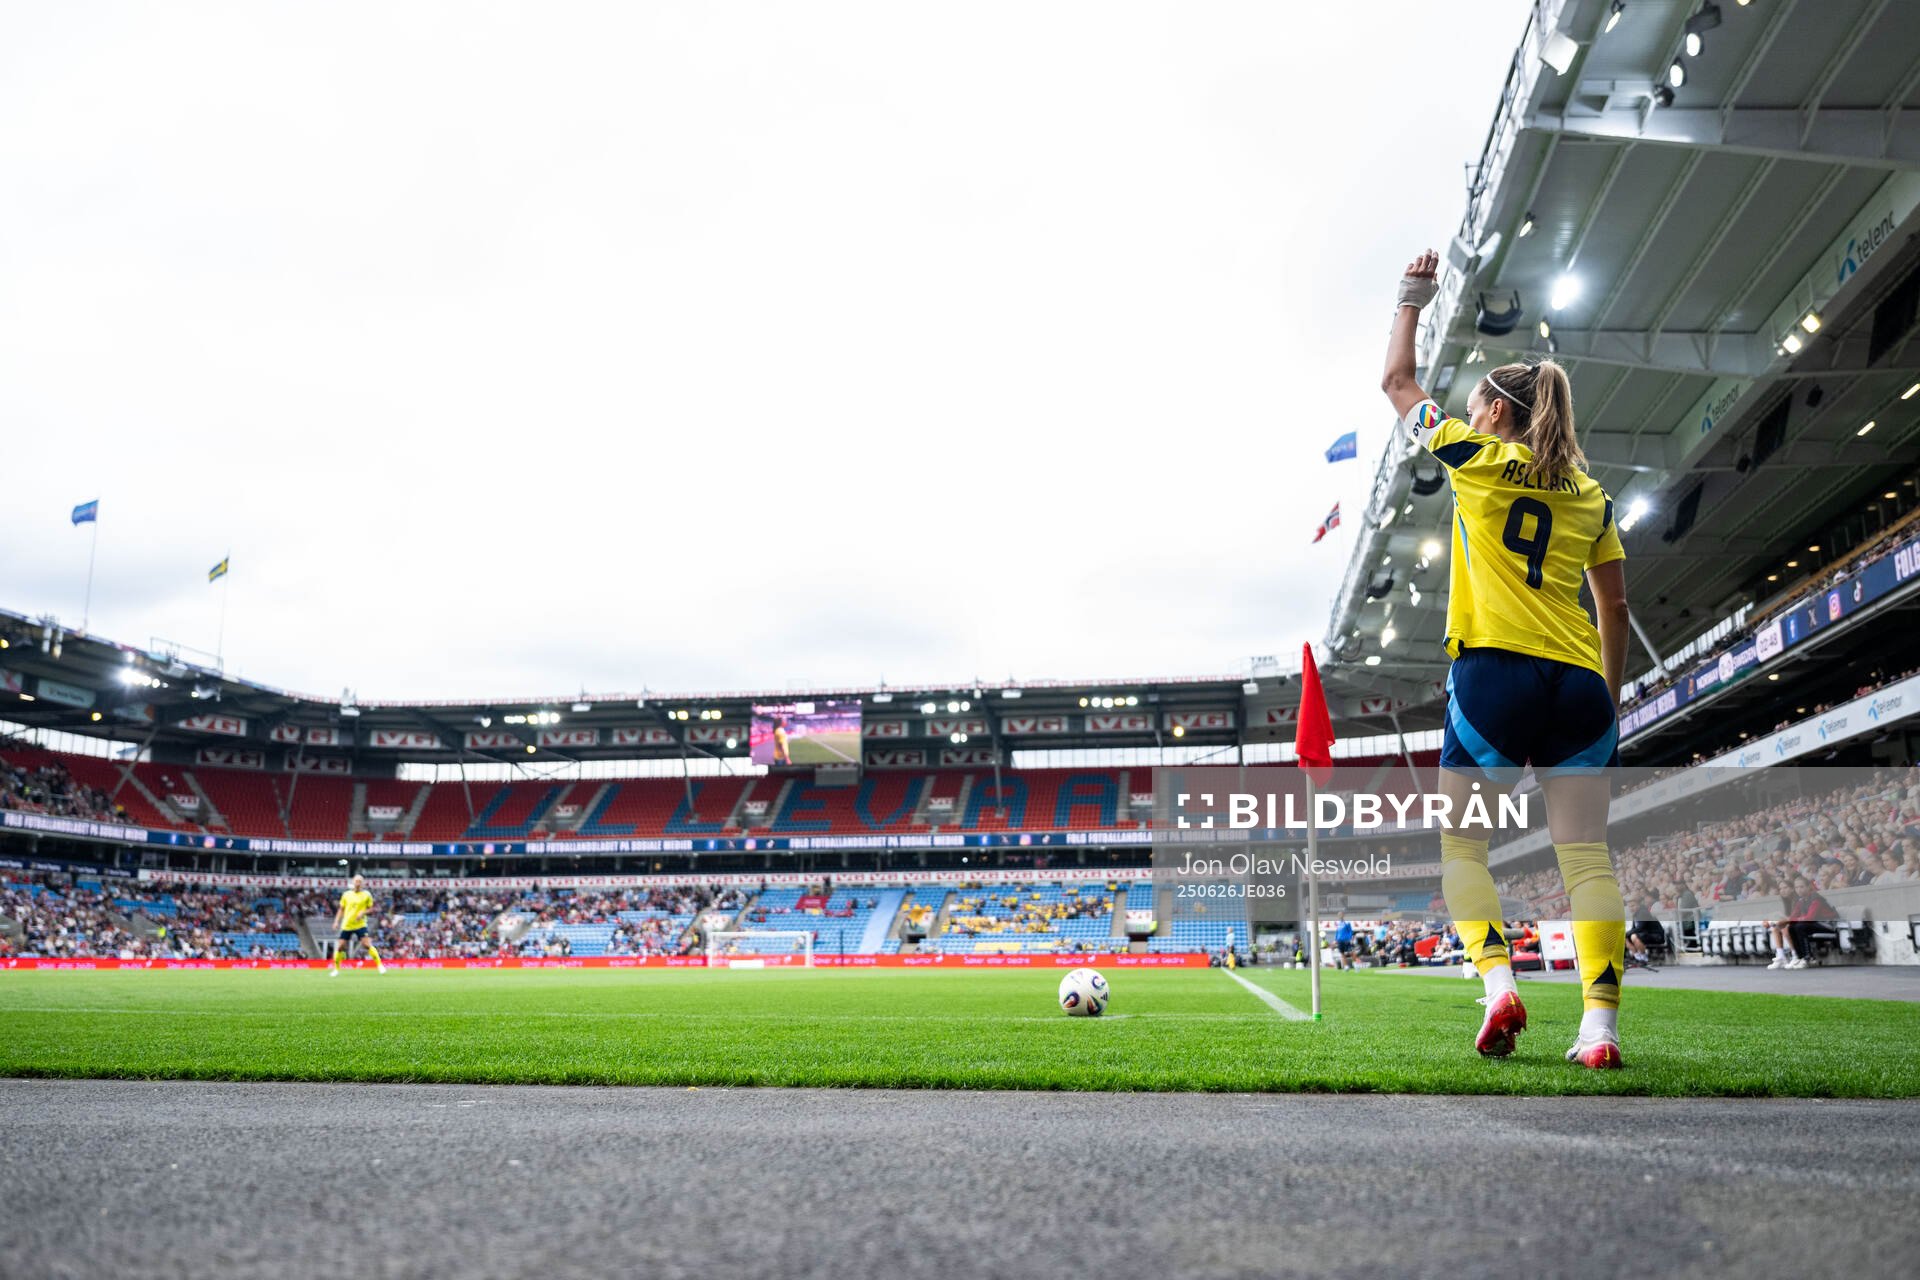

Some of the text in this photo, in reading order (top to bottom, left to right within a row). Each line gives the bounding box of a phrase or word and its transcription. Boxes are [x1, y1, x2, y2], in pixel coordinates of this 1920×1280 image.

[1502, 496, 1553, 590] 9
[930, 720, 986, 736] VG
[1007, 718, 1064, 733] VG
[1090, 715, 1149, 730] VG
[1170, 712, 1228, 728] VG
[377, 730, 436, 746] VG
[542, 730, 598, 746] VG
[689, 727, 743, 742] VG
